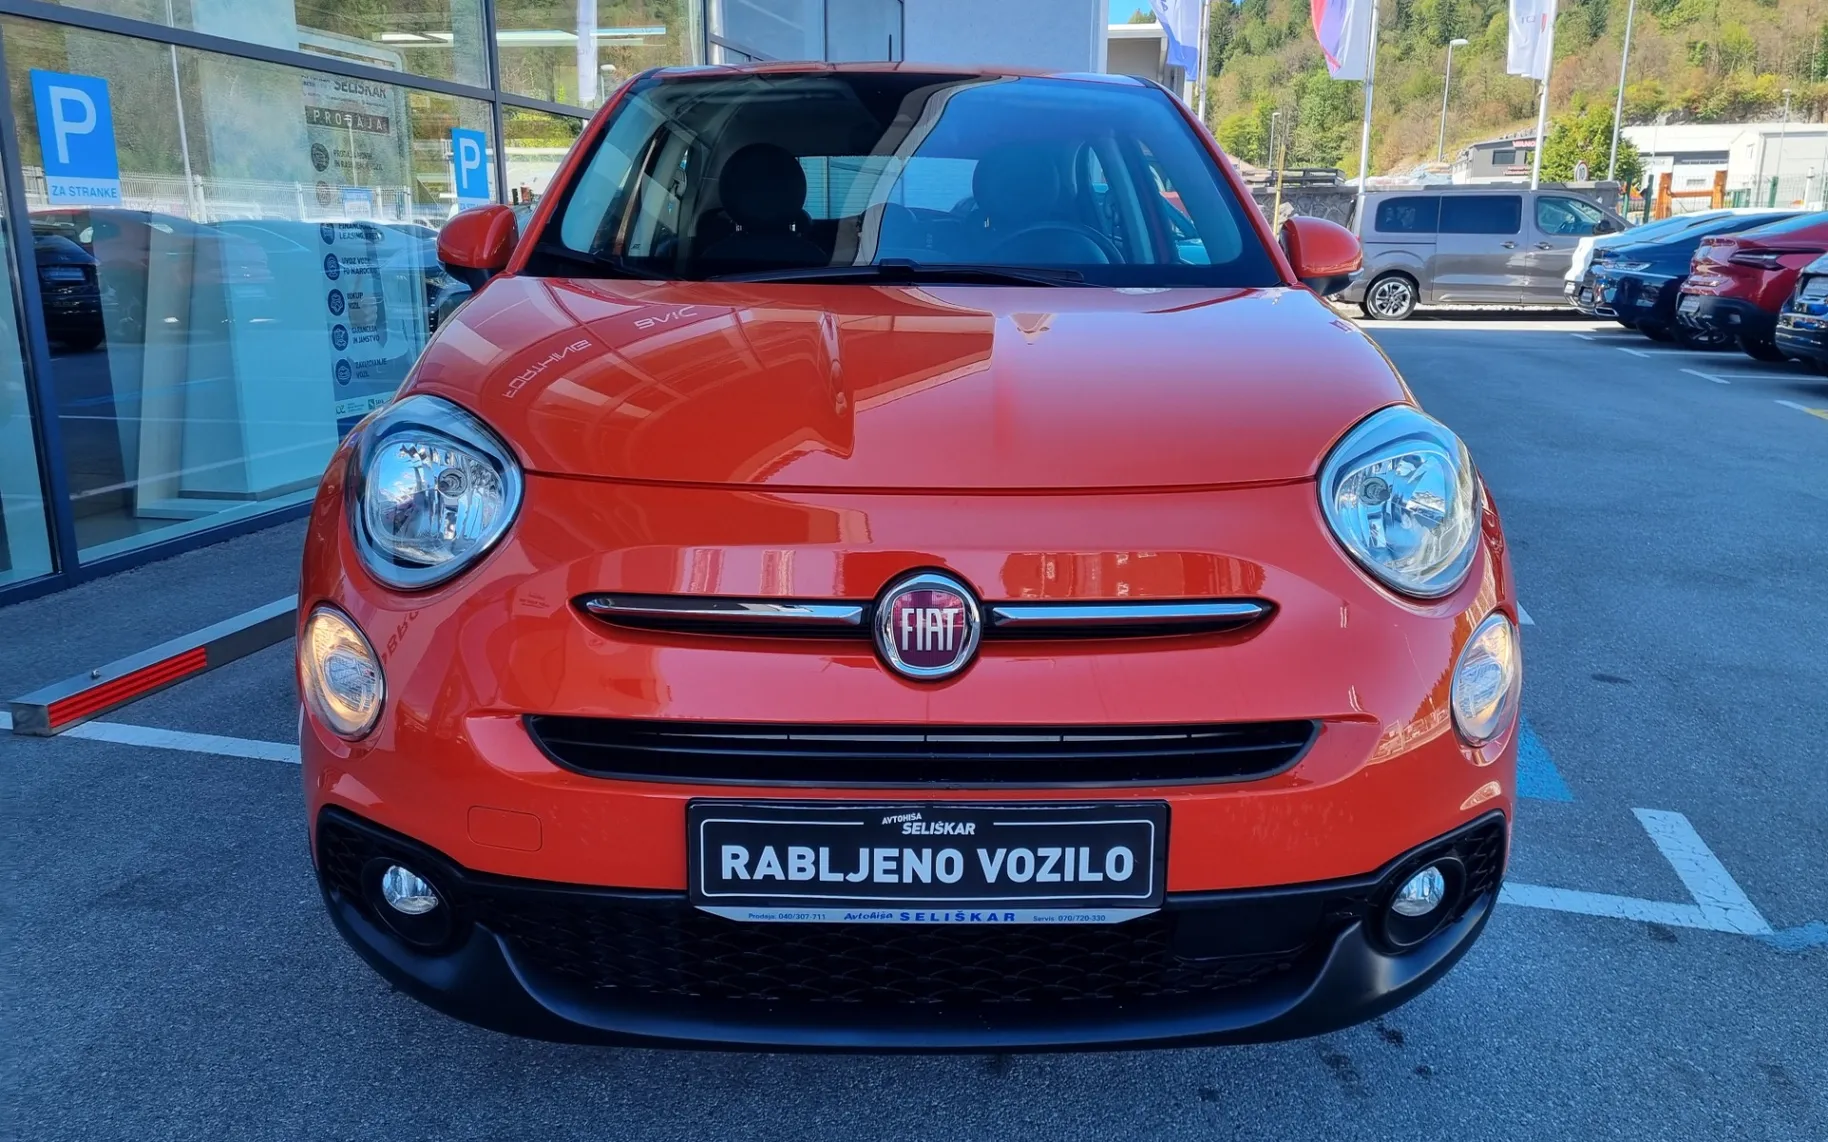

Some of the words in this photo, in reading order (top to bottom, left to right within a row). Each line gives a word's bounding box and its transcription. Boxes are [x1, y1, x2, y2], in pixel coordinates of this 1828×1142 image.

[48, 85, 97, 164] P
[313, 109, 383, 131] PROAJA
[459, 138, 480, 189] P
[52, 185, 66, 197] ZA
[68, 185, 118, 198] STRANKE
[901, 608, 959, 651] FIAT
[902, 821, 976, 835] SELIŠKAR
[721, 845, 964, 884] RABLJENO
[977, 846, 1134, 884] VOZILO
[900, 910, 1015, 922] SELIŠKAR
